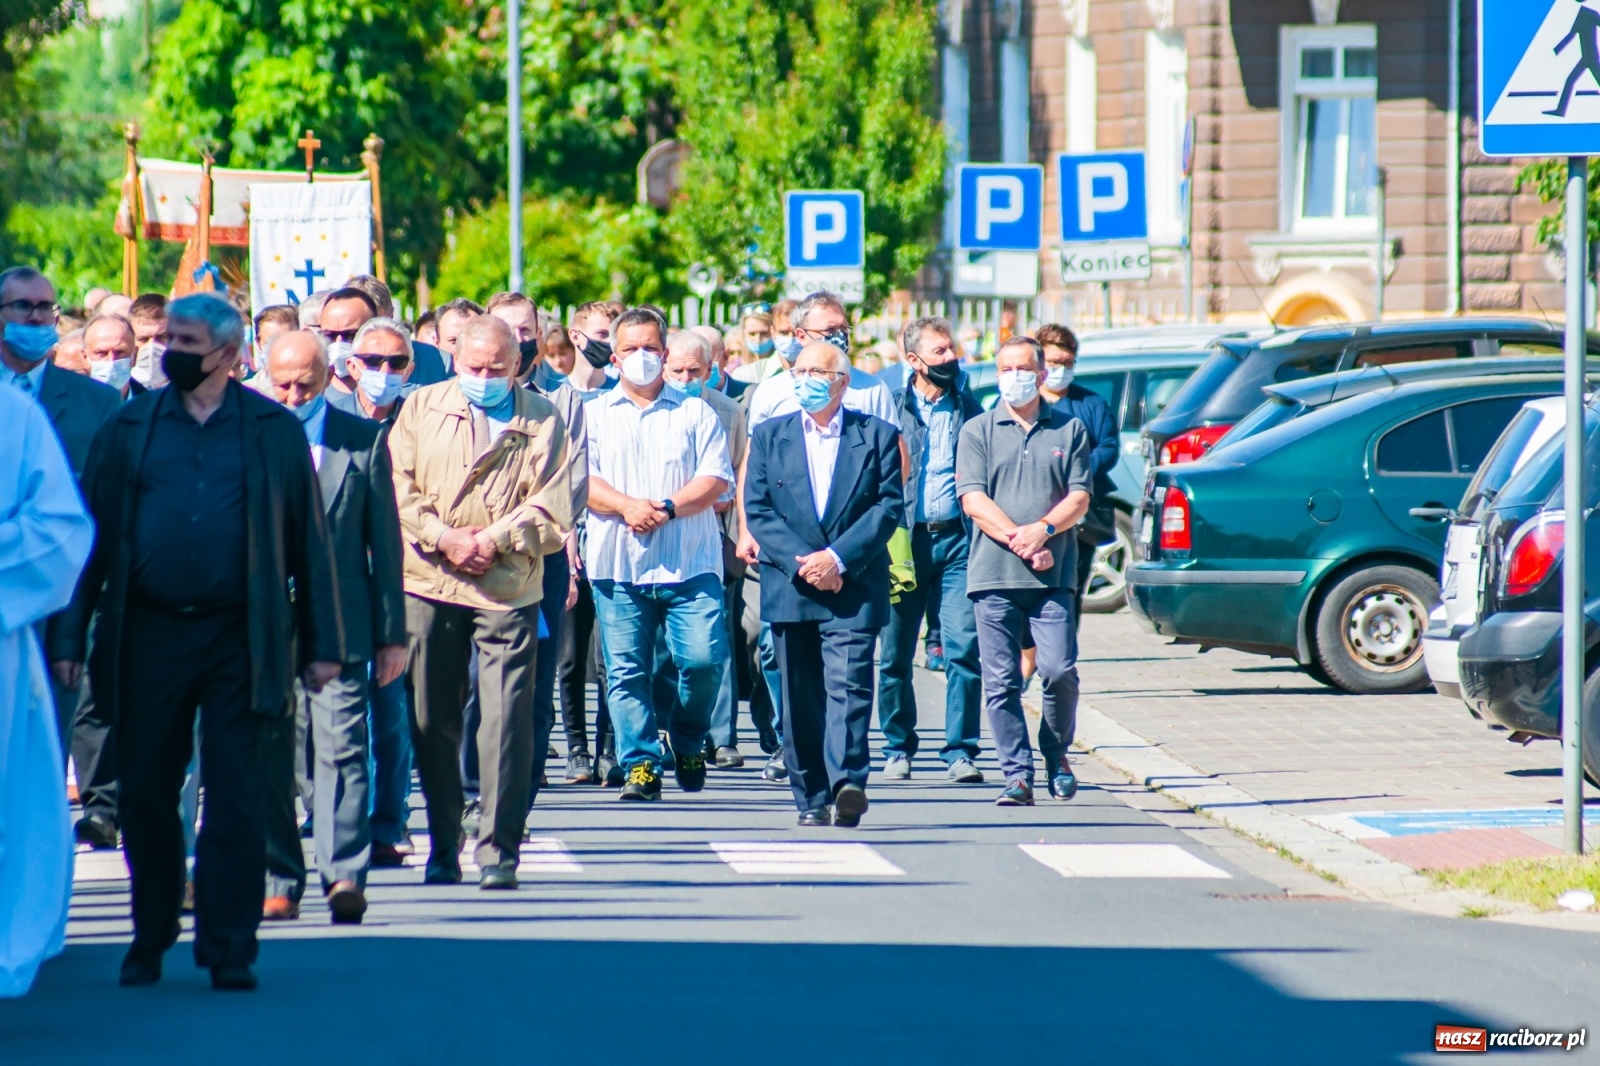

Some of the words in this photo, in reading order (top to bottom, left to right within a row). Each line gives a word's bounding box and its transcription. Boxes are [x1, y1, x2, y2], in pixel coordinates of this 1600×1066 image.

[975, 176, 1024, 241] P
[1077, 162, 1129, 233] P
[802, 200, 847, 261] P
[1062, 250, 1149, 273] Koniec
